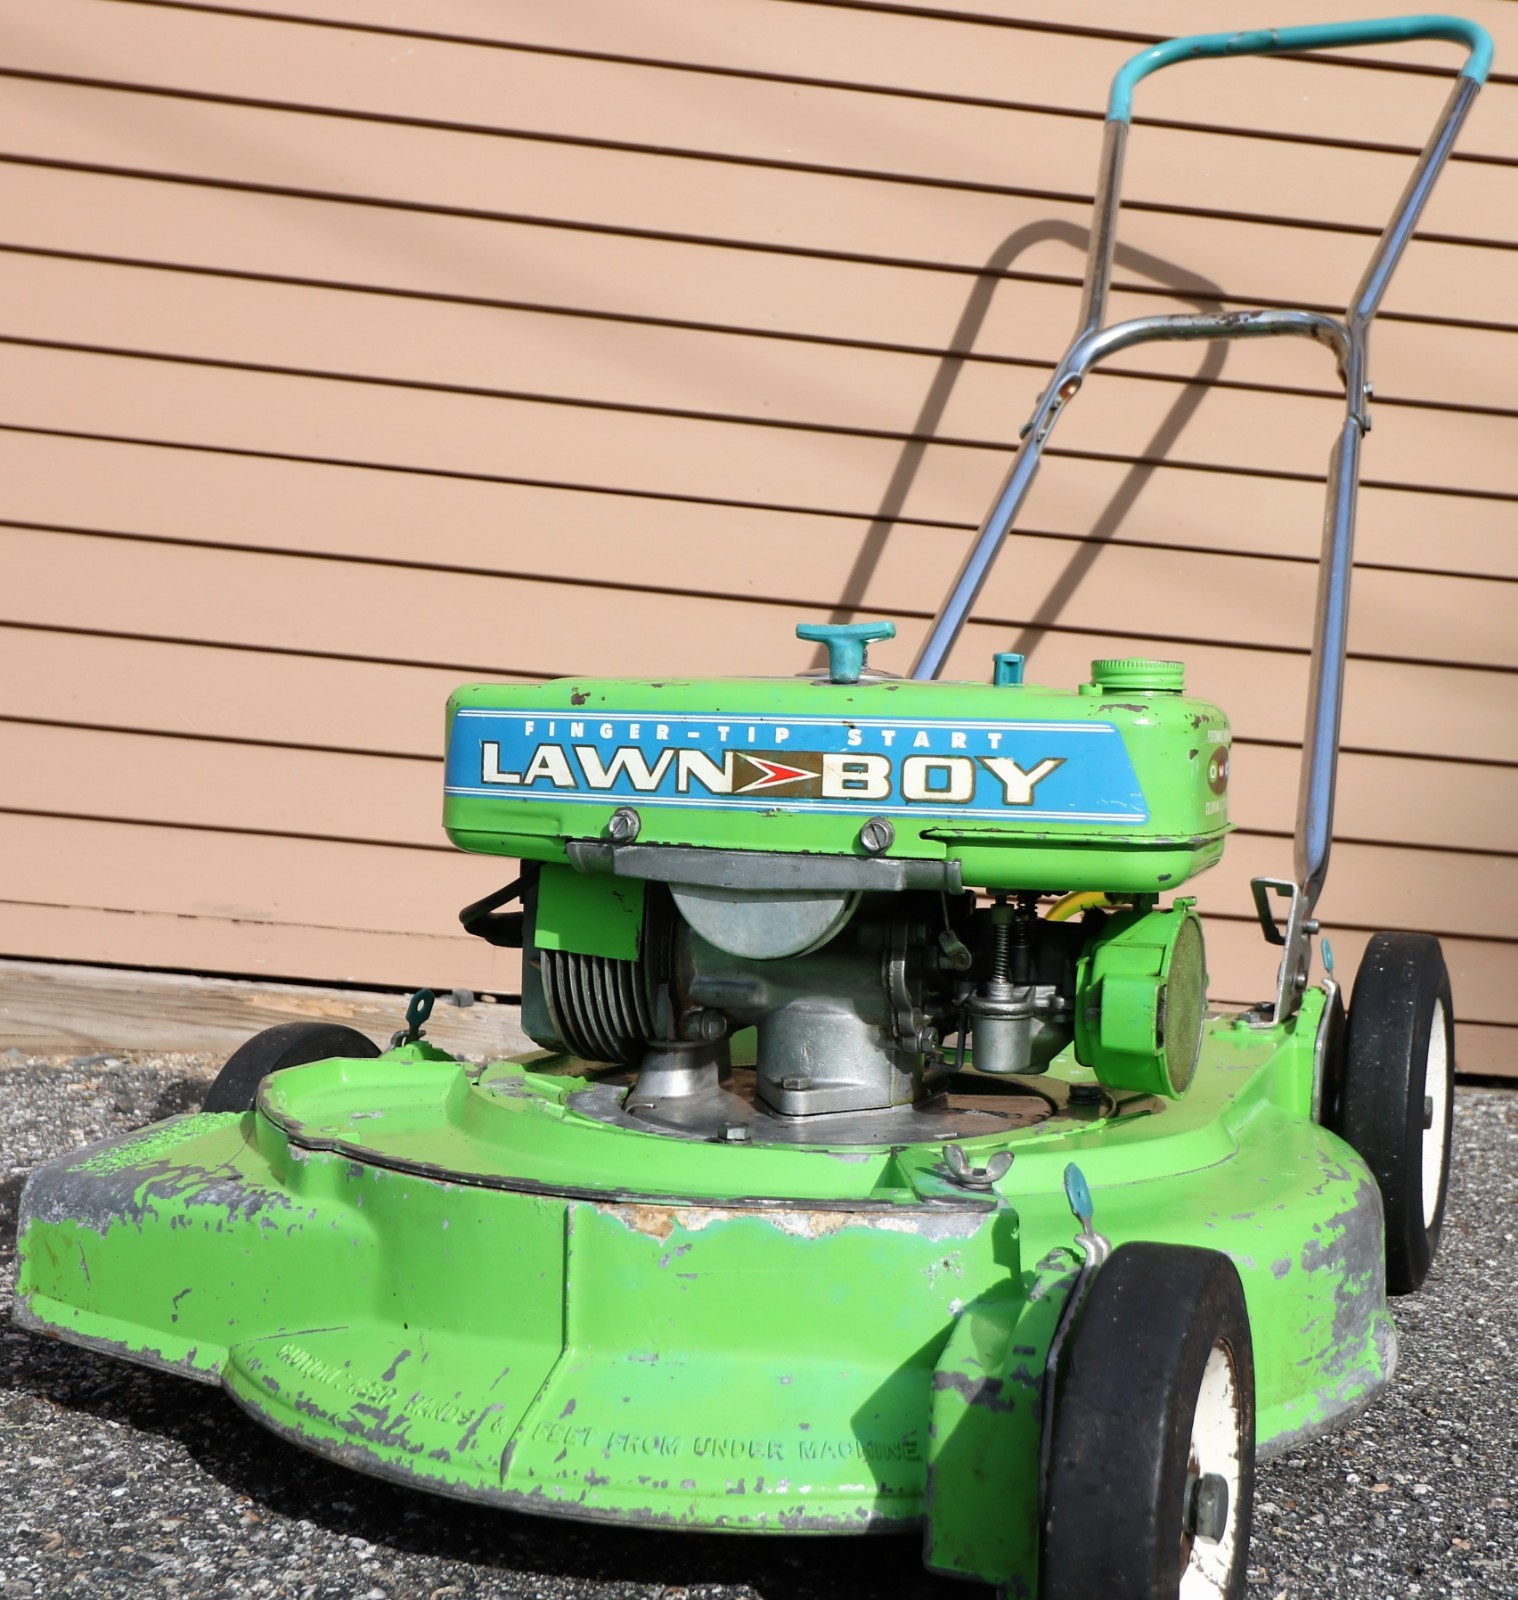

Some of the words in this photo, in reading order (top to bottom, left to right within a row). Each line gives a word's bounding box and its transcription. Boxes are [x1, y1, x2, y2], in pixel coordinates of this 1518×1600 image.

[847, 728, 1003, 750] START
[480, 740, 735, 795] LAWN
[821, 752, 1067, 806] BOY
[402, 1390, 476, 1427] HANDS
[532, 1421, 598, 1448] FEET
[606, 1431, 682, 1457] FROM
[692, 1435, 784, 1461] UNDER
[798, 1434, 923, 1463] MACHINE
